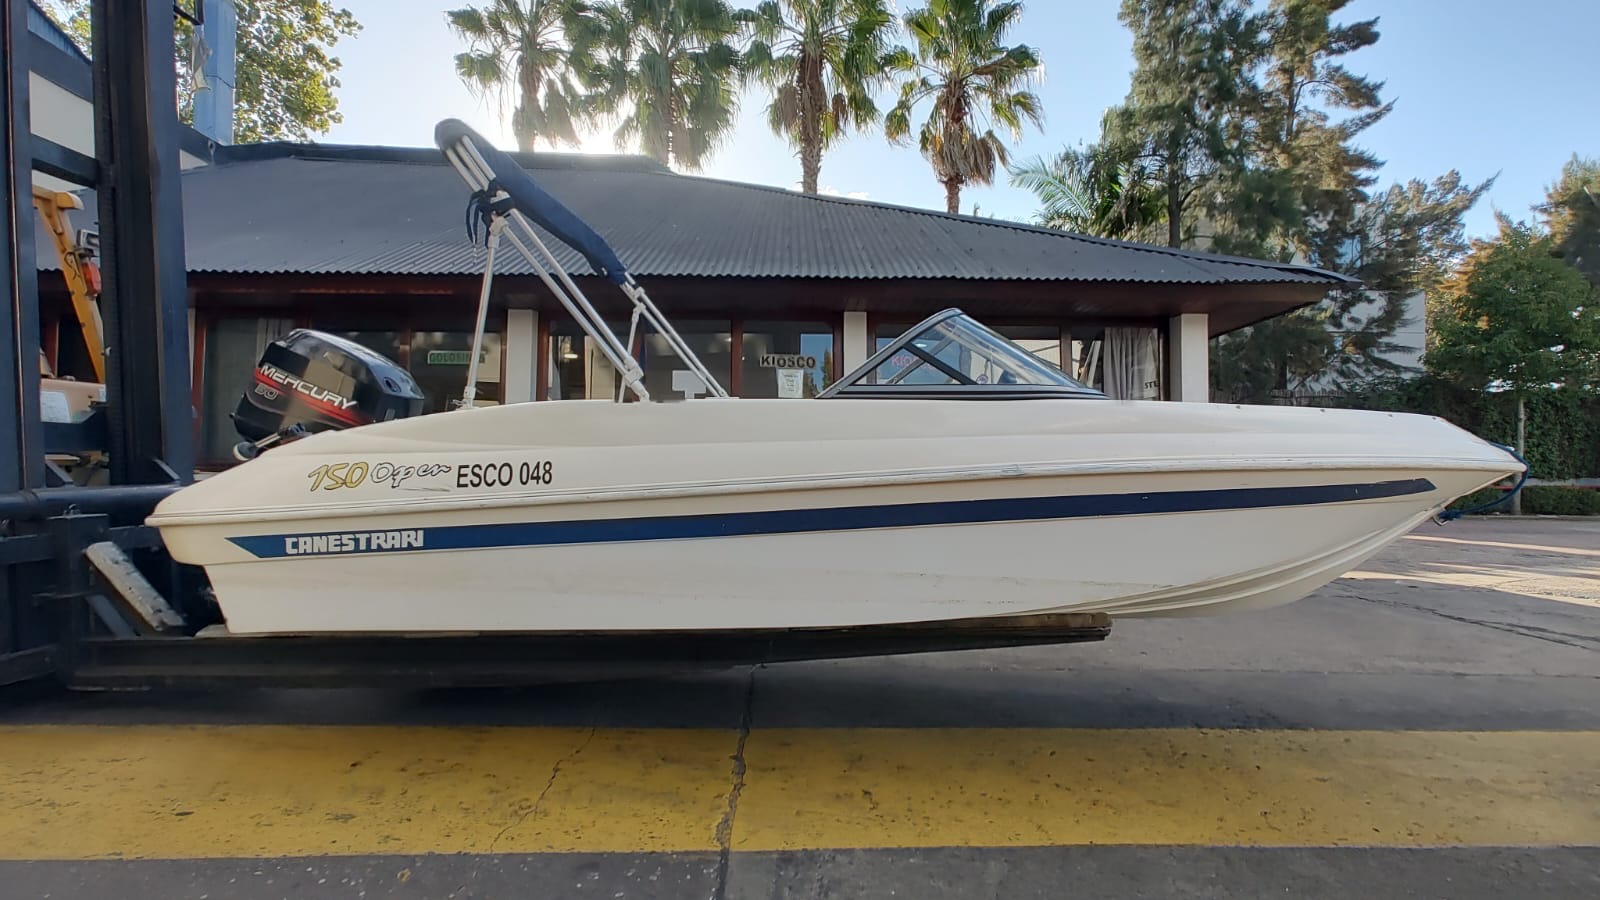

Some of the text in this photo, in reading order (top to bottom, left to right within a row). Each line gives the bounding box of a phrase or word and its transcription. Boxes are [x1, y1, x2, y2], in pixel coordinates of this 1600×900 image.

[761, 355, 816, 369] KIOSCO
[260, 365, 358, 410] MERCURY
[370, 461, 451, 489] Open
[456, 461, 553, 488] ESCO 048
[285, 529, 425, 555] CANESTRARI
